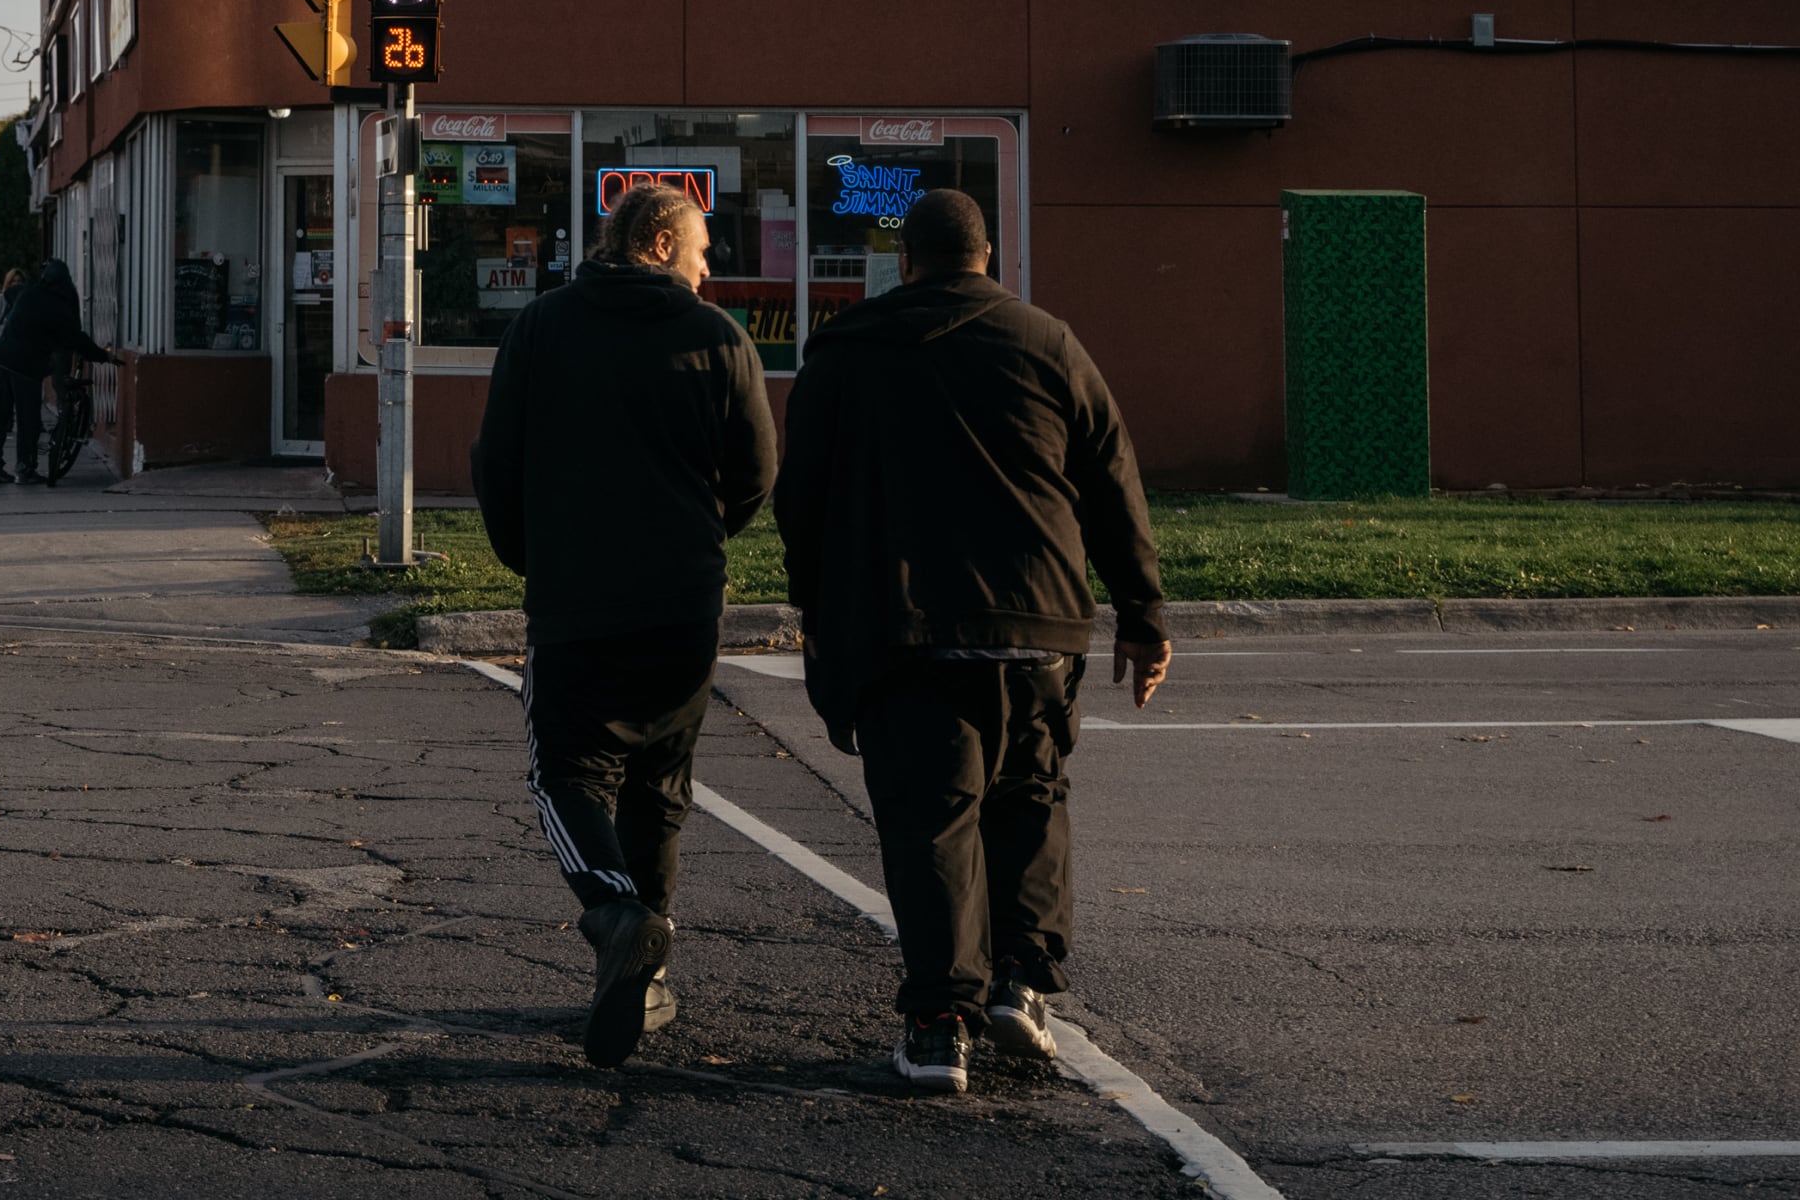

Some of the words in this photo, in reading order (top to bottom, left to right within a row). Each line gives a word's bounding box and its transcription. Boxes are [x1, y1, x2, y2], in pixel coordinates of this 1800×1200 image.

[385, 28, 424, 68] 26
[432, 115, 497, 137] Coca-Cola
[869, 119, 935, 142] Coca-Cola
[837, 157, 920, 191] SAINT
[601, 172, 711, 212] ON
[488, 269, 527, 286] ATM
